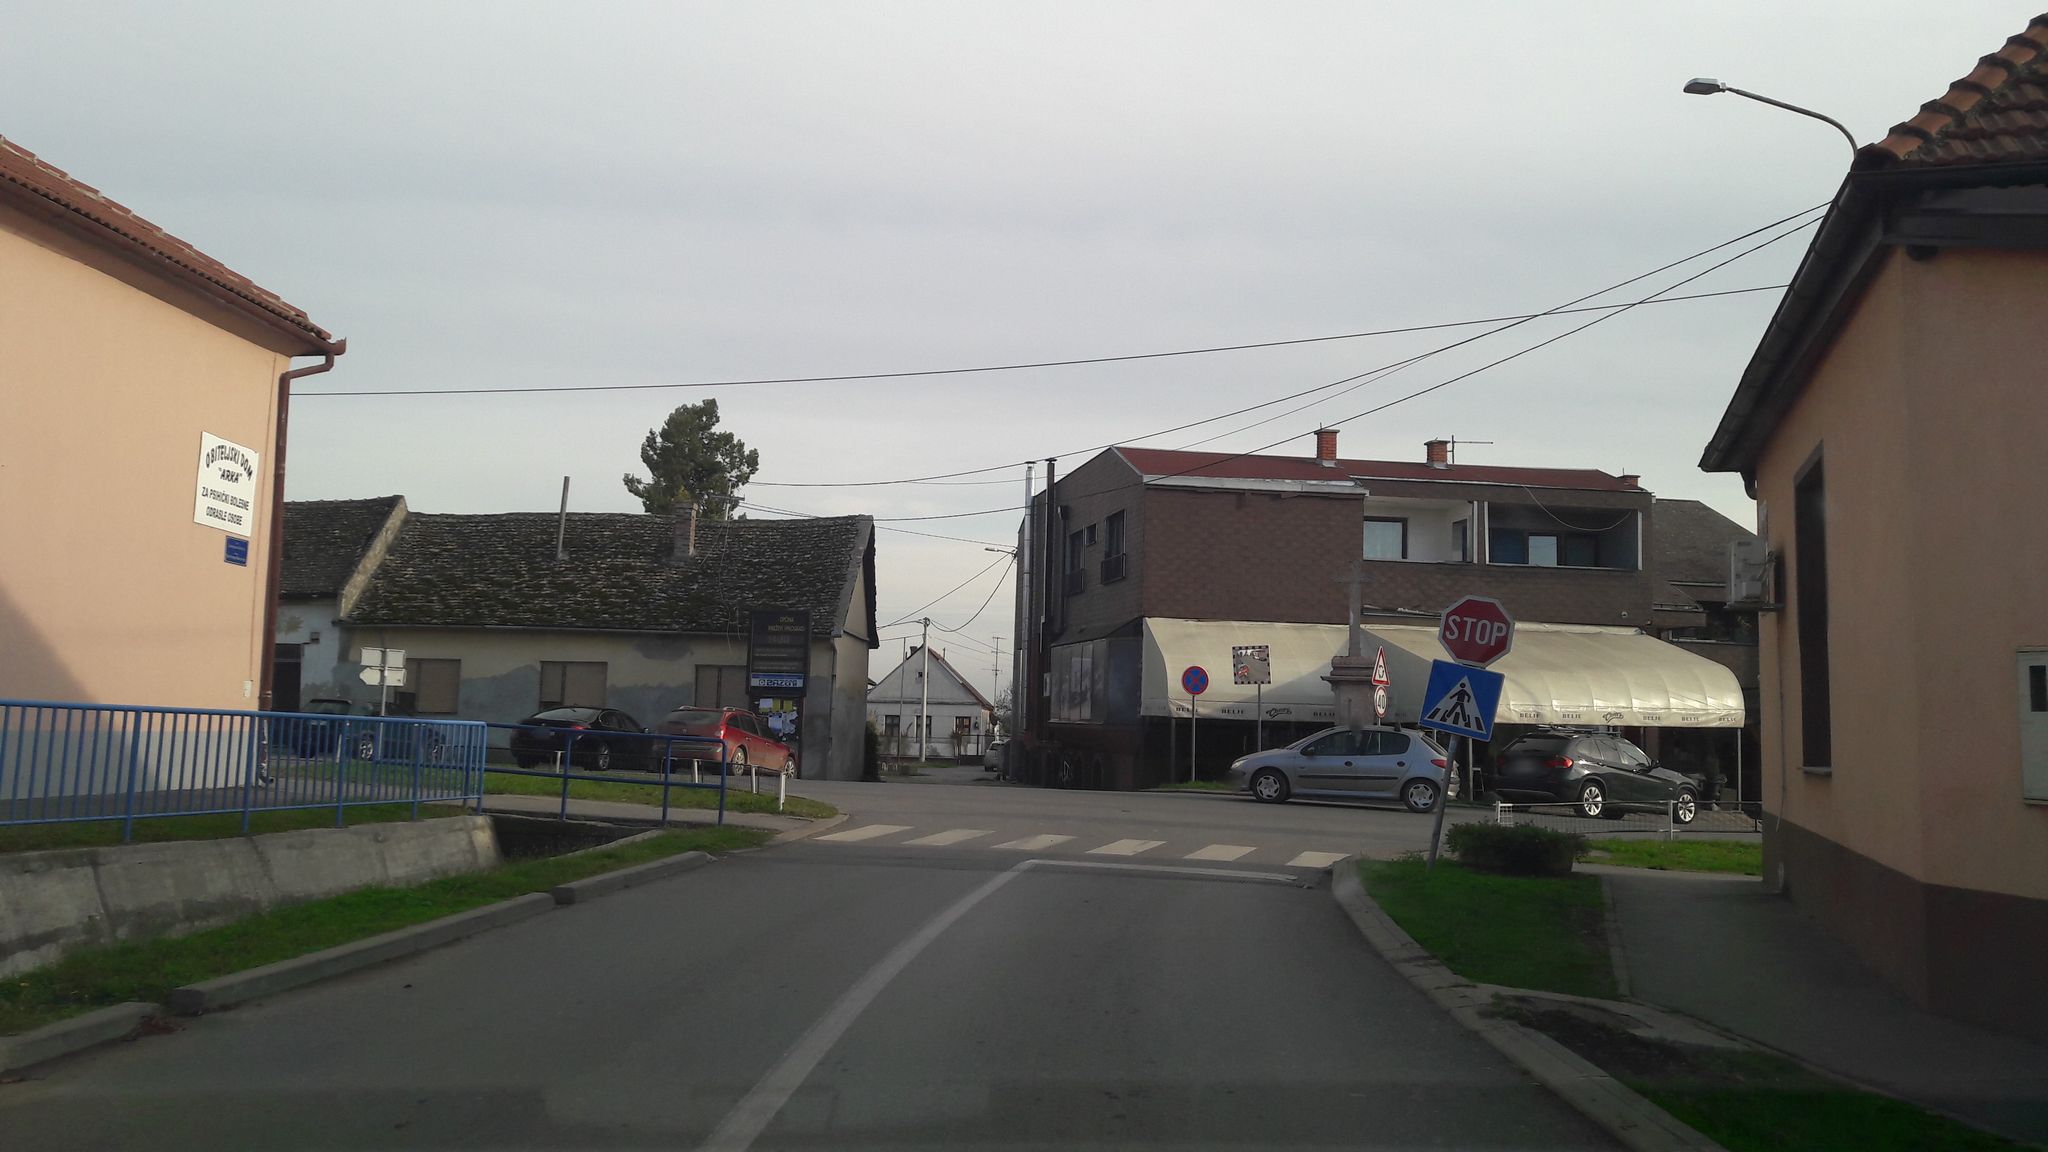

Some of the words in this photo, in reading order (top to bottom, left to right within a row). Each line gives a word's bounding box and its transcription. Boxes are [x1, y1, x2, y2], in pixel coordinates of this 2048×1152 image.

[206, 445, 240, 468] OBITELJSKI
[240, 453, 253, 481] DOM
[202, 486, 208, 498] ZA
[1446, 615, 1507, 646] STOP
[1378, 694, 1385, 710] 40
